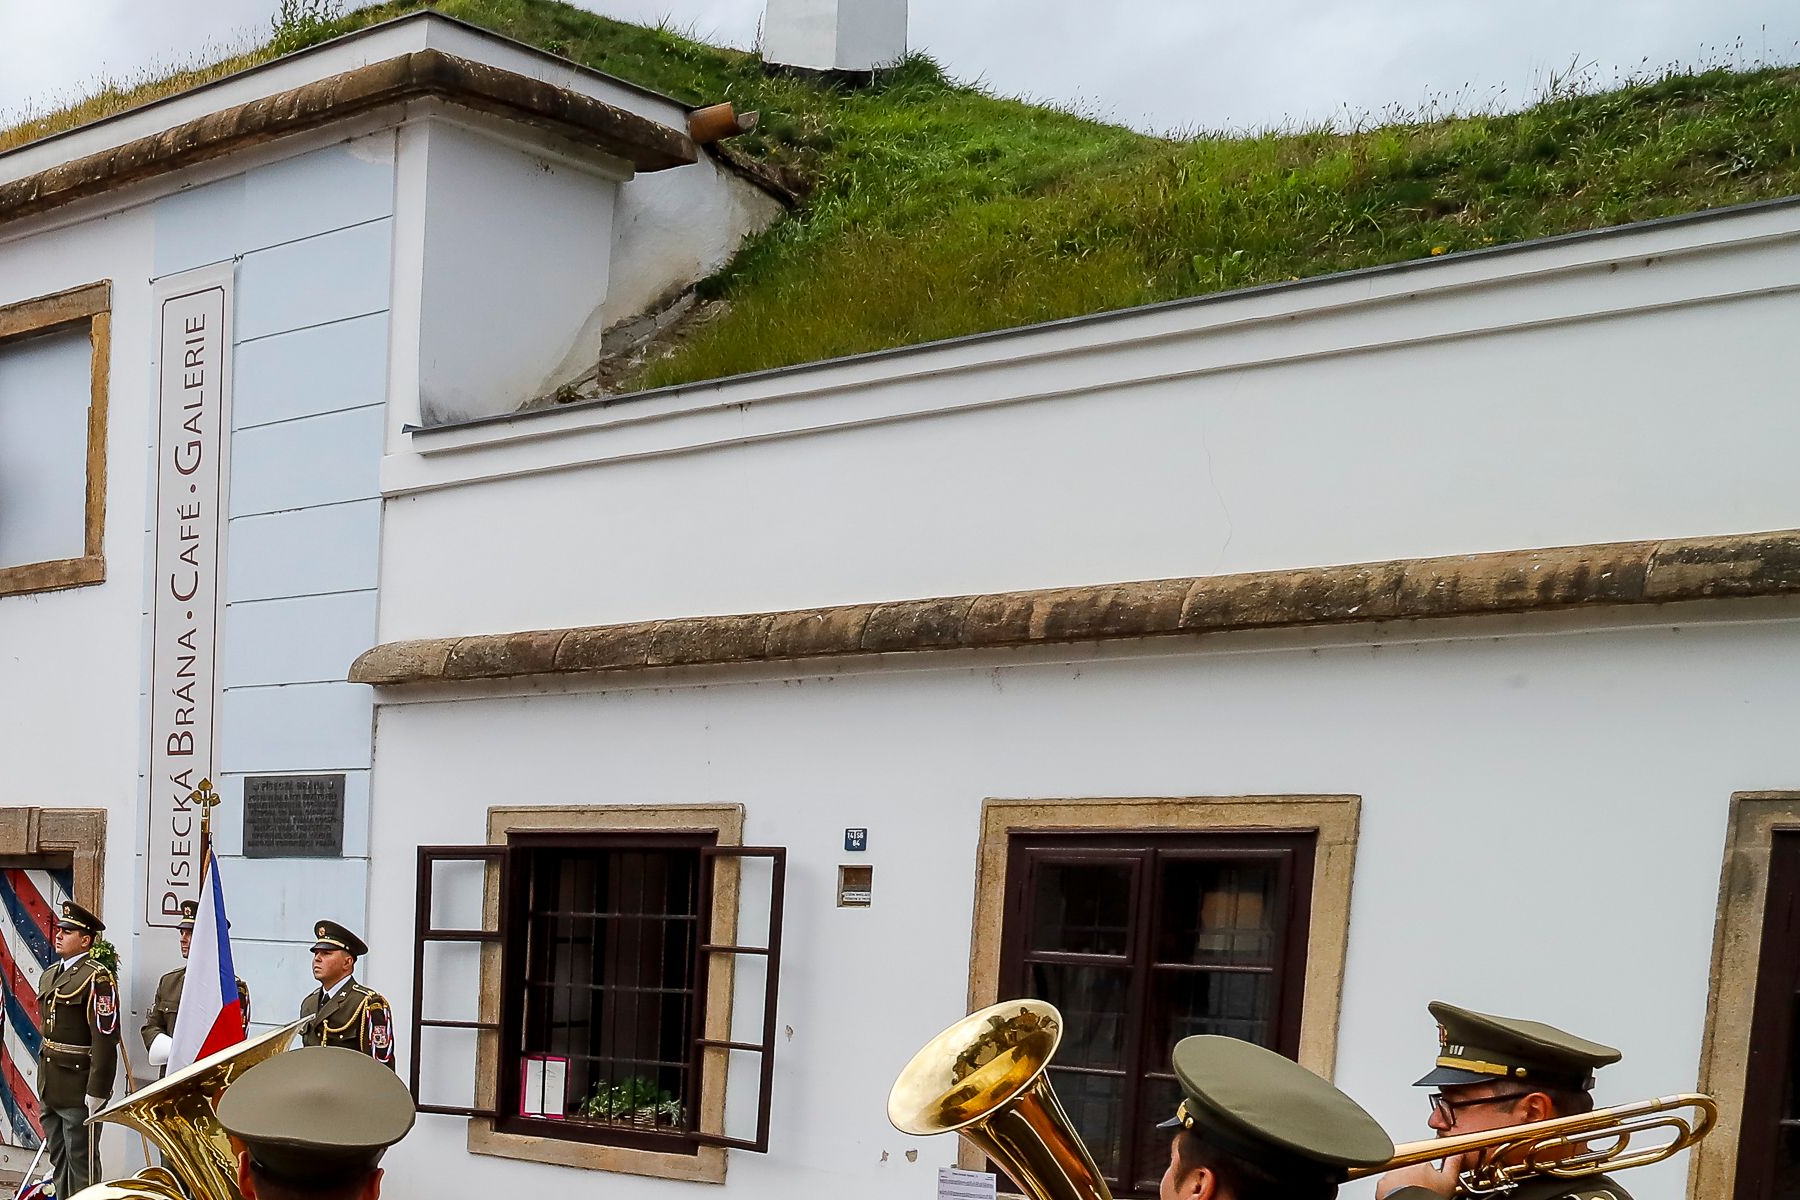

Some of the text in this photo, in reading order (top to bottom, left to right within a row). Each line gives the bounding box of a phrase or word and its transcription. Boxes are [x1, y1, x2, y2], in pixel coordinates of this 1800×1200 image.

[162, 313, 206, 916] PÍSECKÁ BRÁNA CAFÉ GALERIE
